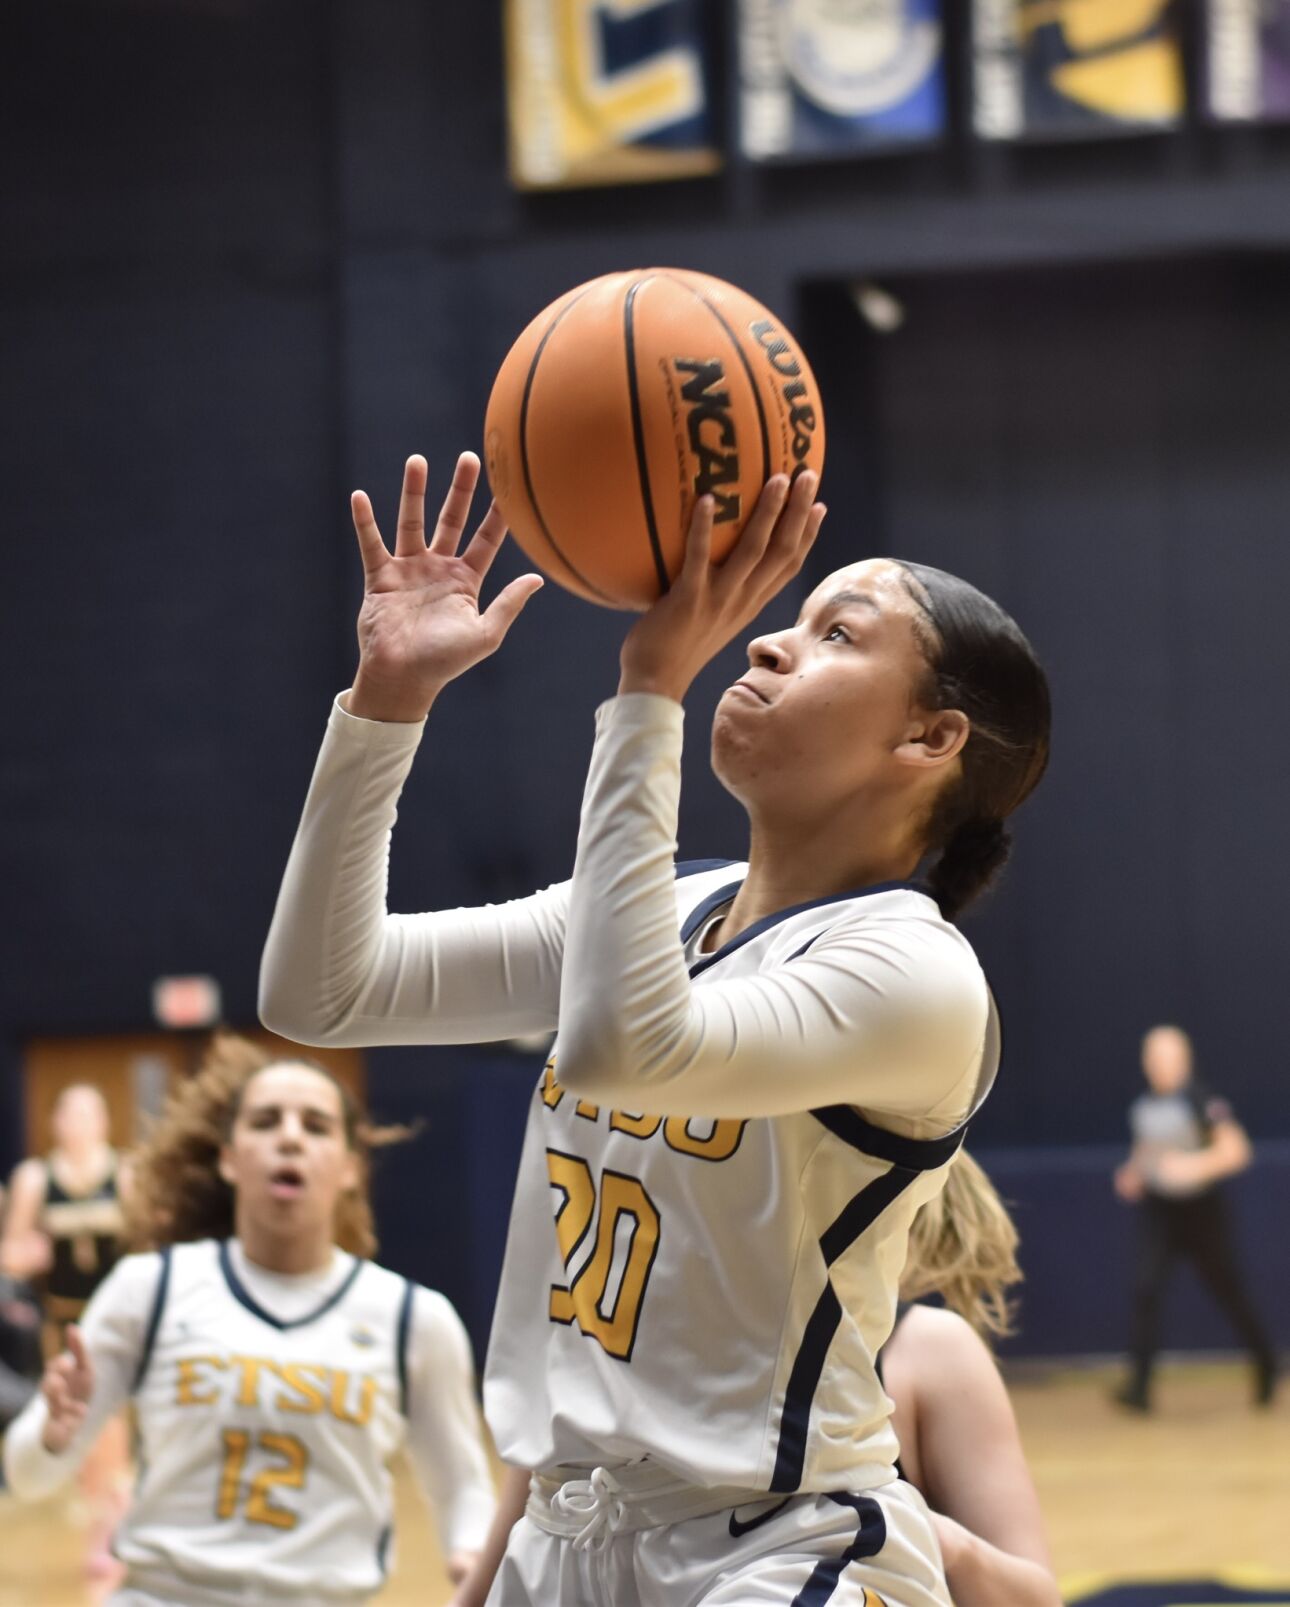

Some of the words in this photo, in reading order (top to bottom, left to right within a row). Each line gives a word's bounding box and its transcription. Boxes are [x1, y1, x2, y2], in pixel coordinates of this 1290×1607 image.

[674, 357, 742, 526] NCAA
[174, 1354, 376, 1427] ETSU
[215, 1429, 309, 1531] 12
